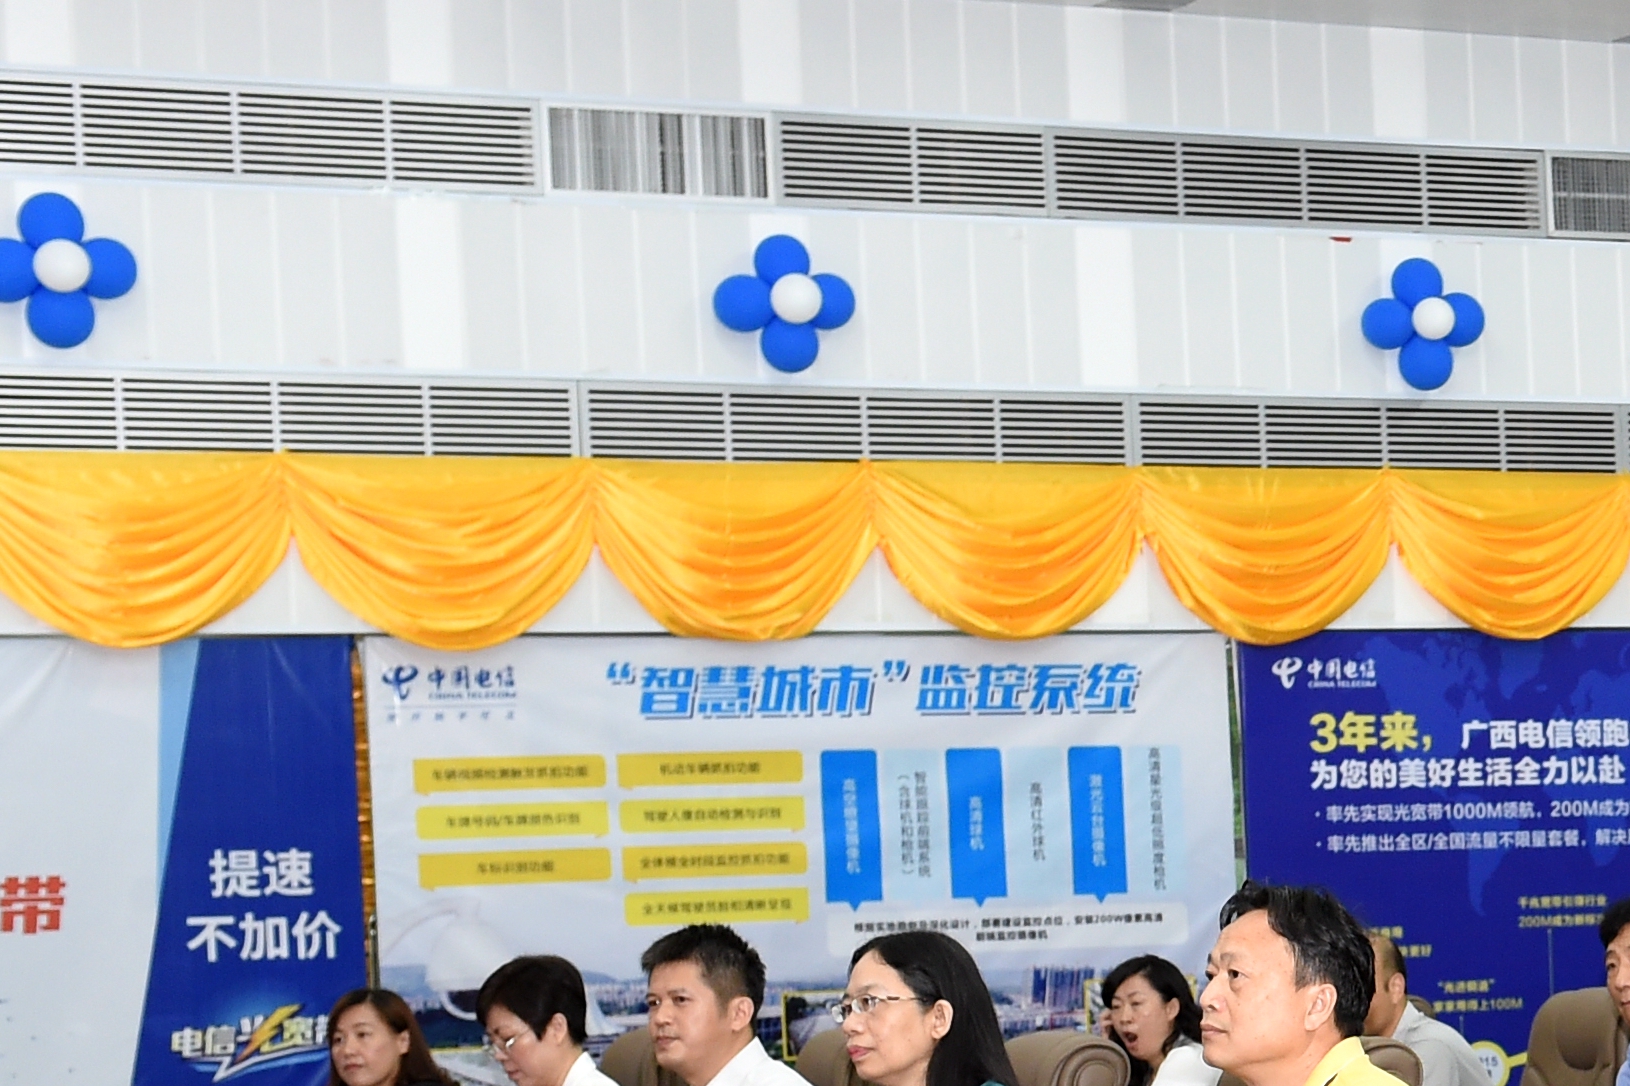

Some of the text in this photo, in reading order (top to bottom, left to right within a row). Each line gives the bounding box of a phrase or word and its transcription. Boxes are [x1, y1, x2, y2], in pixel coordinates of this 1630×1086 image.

[428, 666, 514, 689] 中国电信
[606, 659, 1142, 719] “智慧城市”监控系统
[1307, 657, 1375, 680] 中国电信
[1310, 755, 1625, 790] 为您的美好生活全力以赴
[209, 848, 314, 898] 提速
[0, 876, 65, 935] 带
[186, 911, 343, 962] 不加价
